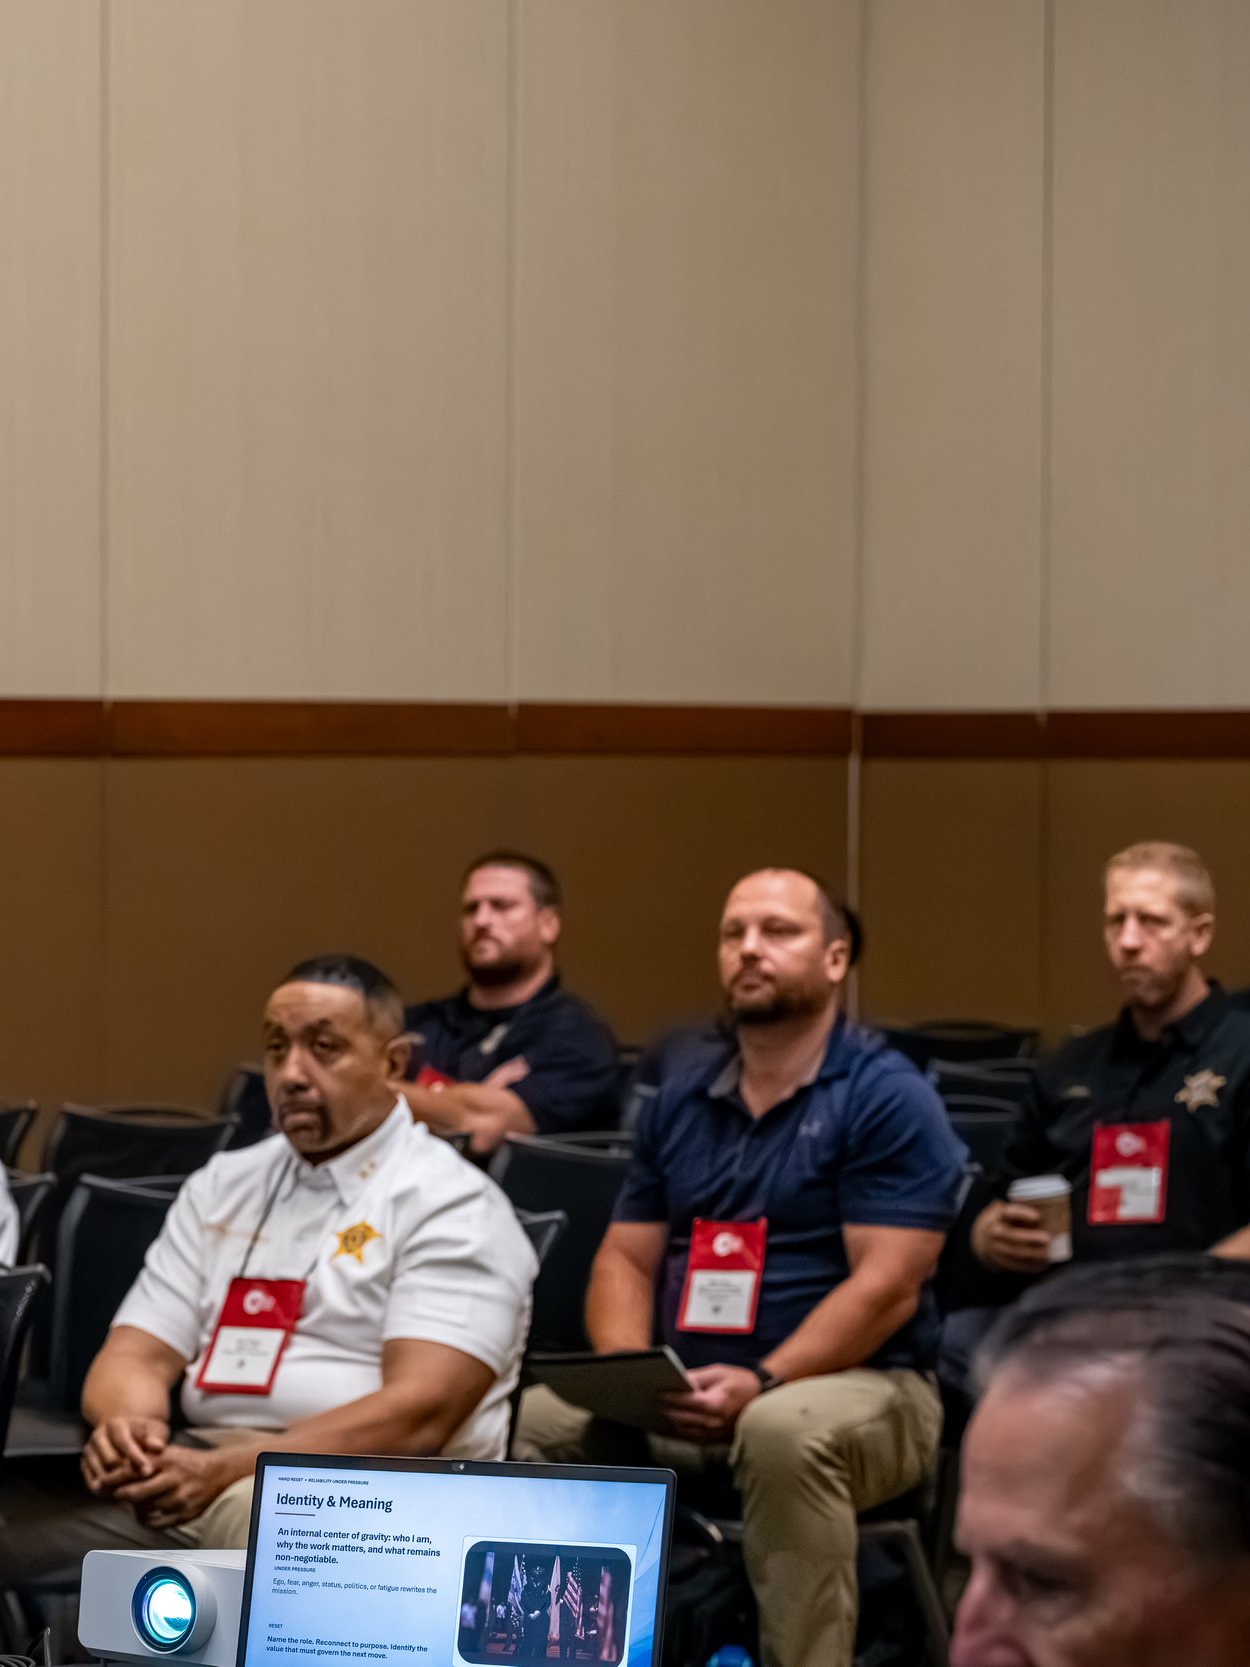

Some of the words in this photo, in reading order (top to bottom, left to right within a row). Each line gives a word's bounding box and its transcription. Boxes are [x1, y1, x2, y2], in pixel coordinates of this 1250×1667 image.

[276, 1493, 324, 1509] Identity
[326, 1496, 336, 1508] &
[340, 1496, 393, 1512] Meaning
[278, 1528, 289, 1536] An
[290, 1528, 322, 1538] internal
[324, 1530, 350, 1540] center
[352, 1532, 360, 1540] of
[361, 1533, 391, 1542] gravity:
[393, 1535, 410, 1543] who
[416, 1537, 432, 1545] am,
[276, 1540, 294, 1550] why
[295, 1541, 308, 1550] the
[310, 1542, 330, 1551] work
[332, 1544, 366, 1554] matters,
[368, 1546, 383, 1554] and
[385, 1547, 406, 1556] what
[407, 1548, 441, 1557] remains
[276, 1553, 338, 1564] non-negotiable.
[273, 1578, 286, 1586] Ego,
[344, 1582, 368, 1590] politics,
[378, 1584, 399, 1592] fatigue
[316, 1638, 350, 1648] Reconnect
[360, 1642, 389, 1651] purpose.
[390, 1644, 416, 1653] Identify
[340, 1649, 351, 1657] the
